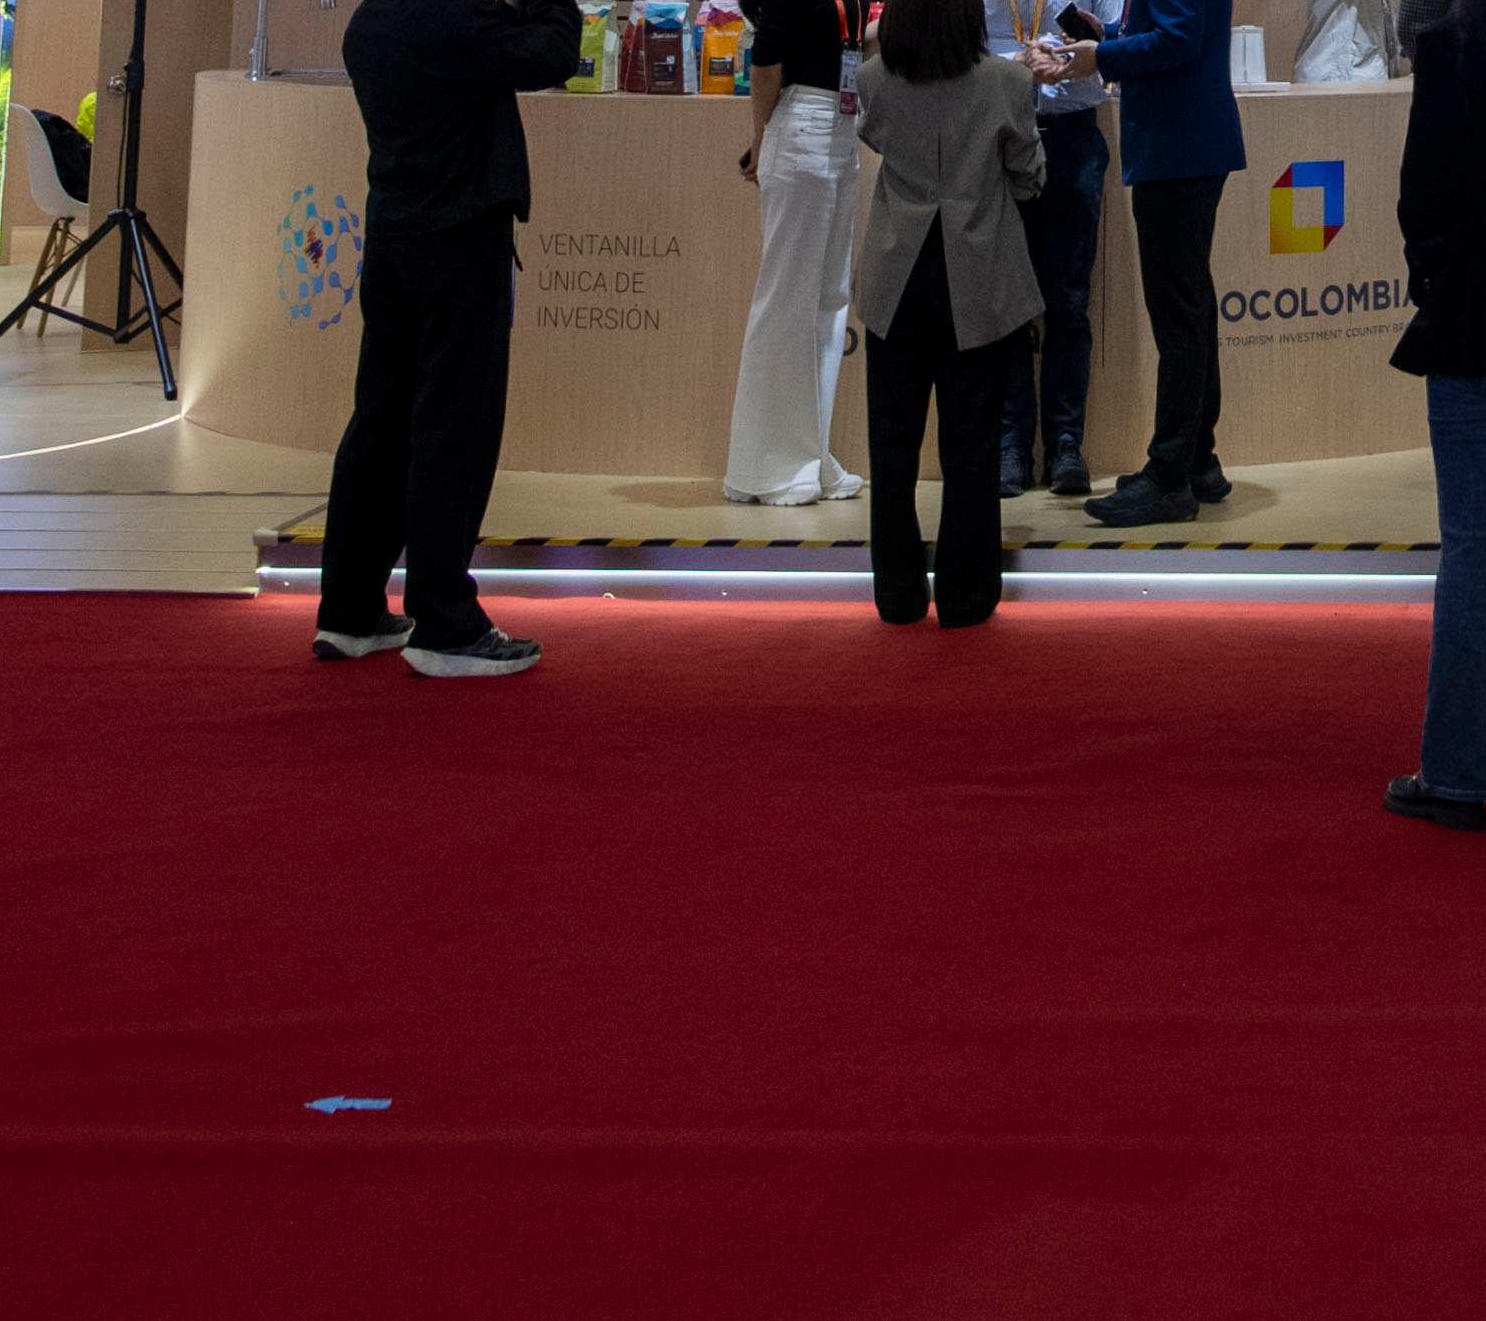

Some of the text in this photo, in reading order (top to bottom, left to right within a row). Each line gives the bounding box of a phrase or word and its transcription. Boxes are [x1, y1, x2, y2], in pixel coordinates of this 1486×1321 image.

[539, 233, 681, 259] VENTANILLA
[538, 265, 645, 295] ÚNICA DE
[1220, 278, 1413, 323] OCOLOMBI
[537, 305, 661, 332] INVERSIÓN
[1226, 334, 1274, 347] TOURISM
[1279, 329, 1342, 344] INVESTMENT
[1346, 324, 1390, 339] COUNTRY
